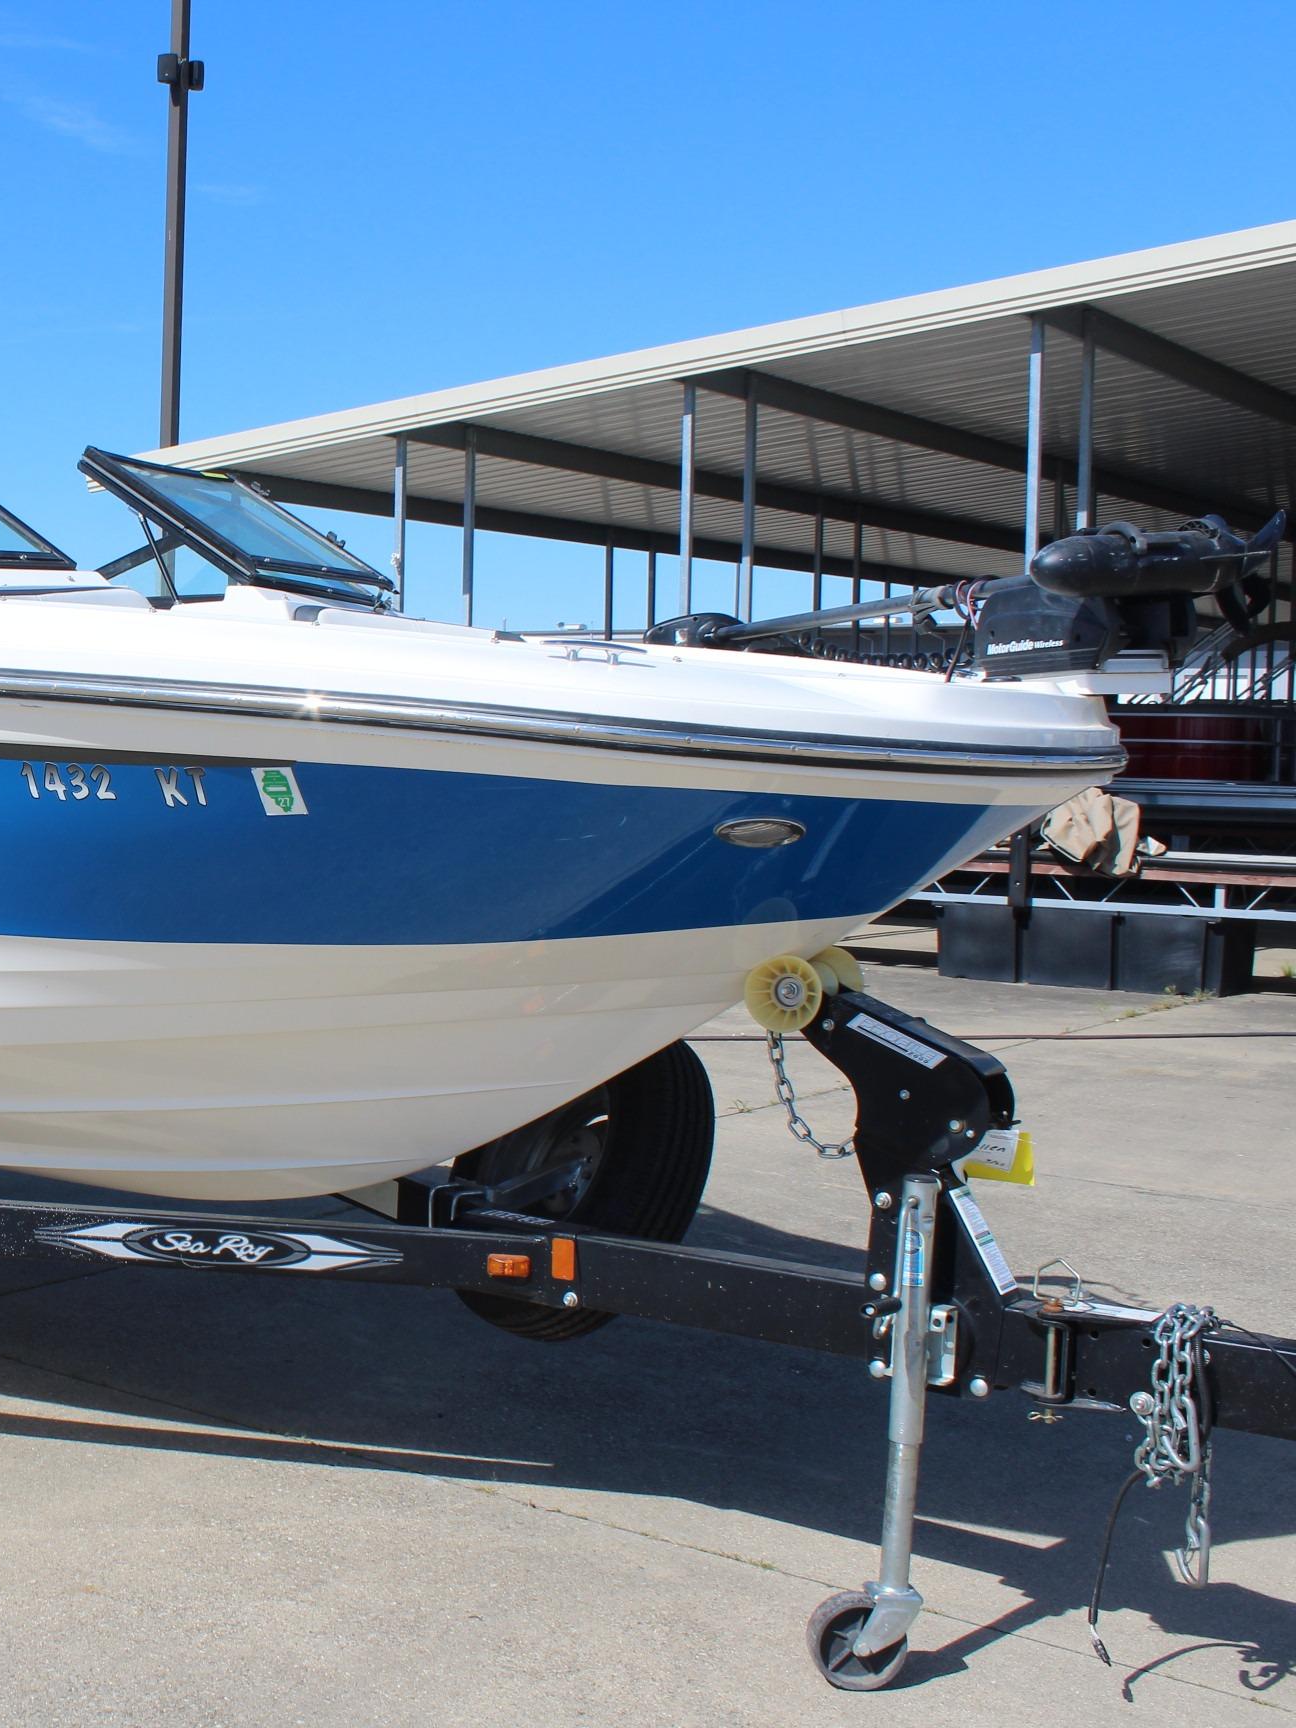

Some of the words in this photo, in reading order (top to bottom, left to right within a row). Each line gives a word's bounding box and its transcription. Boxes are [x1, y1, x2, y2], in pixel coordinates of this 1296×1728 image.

[987, 639, 1033, 655] MotorGuide
[1035, 640, 1064, 648] Wireless
[20, 761, 117, 801] 1432
[154, 766, 207, 808] KT
[860, 1018, 936, 1060] PROFILE
[152, 1233, 210, 1253] Sea
[212, 1234, 274, 1262] Ray
